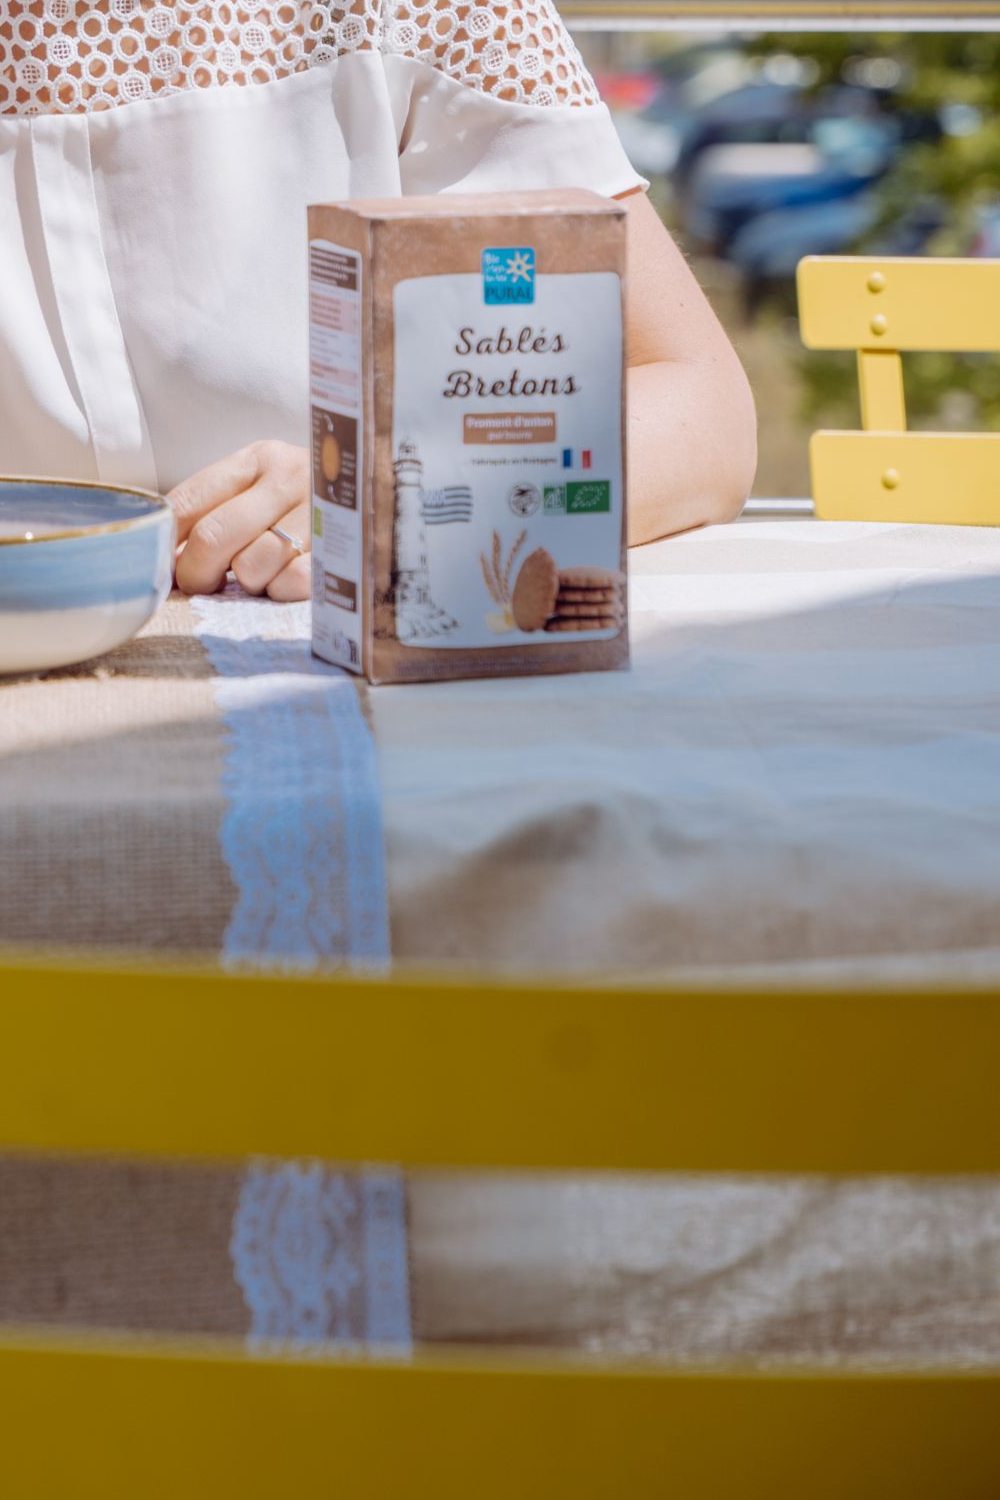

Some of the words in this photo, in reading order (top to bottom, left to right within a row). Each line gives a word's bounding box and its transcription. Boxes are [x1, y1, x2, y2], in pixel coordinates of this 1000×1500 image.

[485, 286, 531, 301] PURAL
[455, 326, 568, 355] Sablés
[443, 369, 581, 398] Bretons
[468, 417, 511, 428] Froment
